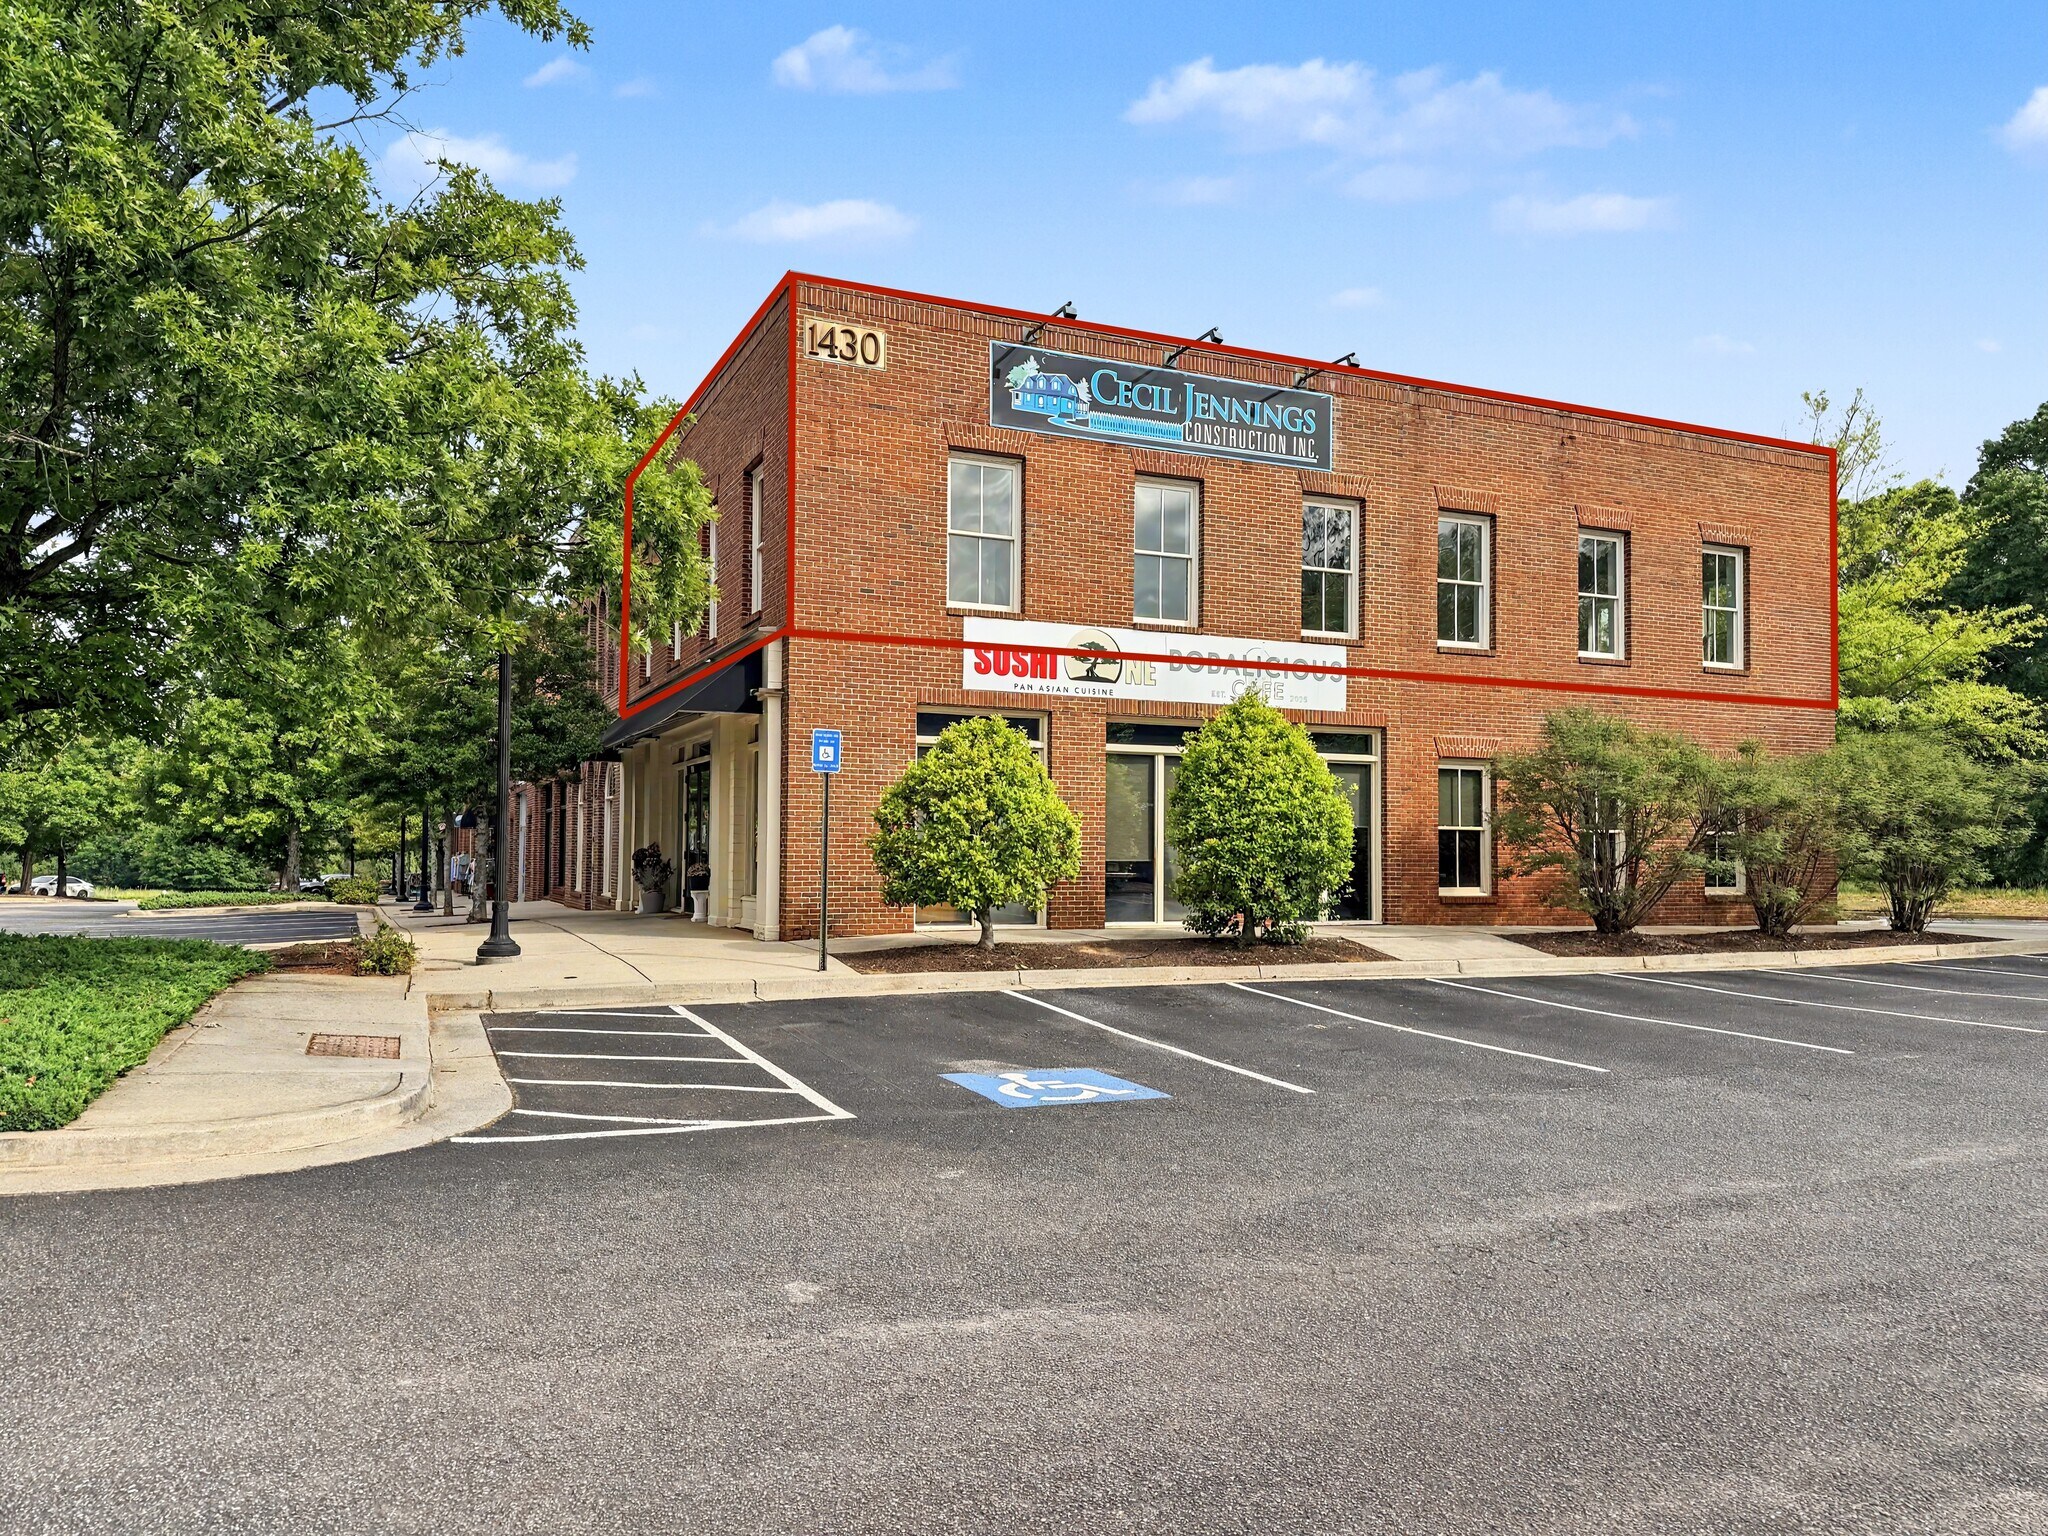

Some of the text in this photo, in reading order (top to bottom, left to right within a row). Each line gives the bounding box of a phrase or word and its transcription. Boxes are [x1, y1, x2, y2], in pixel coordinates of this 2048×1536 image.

[808, 323, 881, 364] 1430
[1090, 369, 1317, 435] CECIL JENNINGS
[1185, 421, 1320, 460] CONSTRUCTION INC.
[974, 648, 1058, 680] SUSHI
[1169, 648, 1343, 683] BOBALICIOUS
[1013, 683, 1114, 697] PAN ASIAN CUISINE
[1231, 679, 1284, 700] CFE
